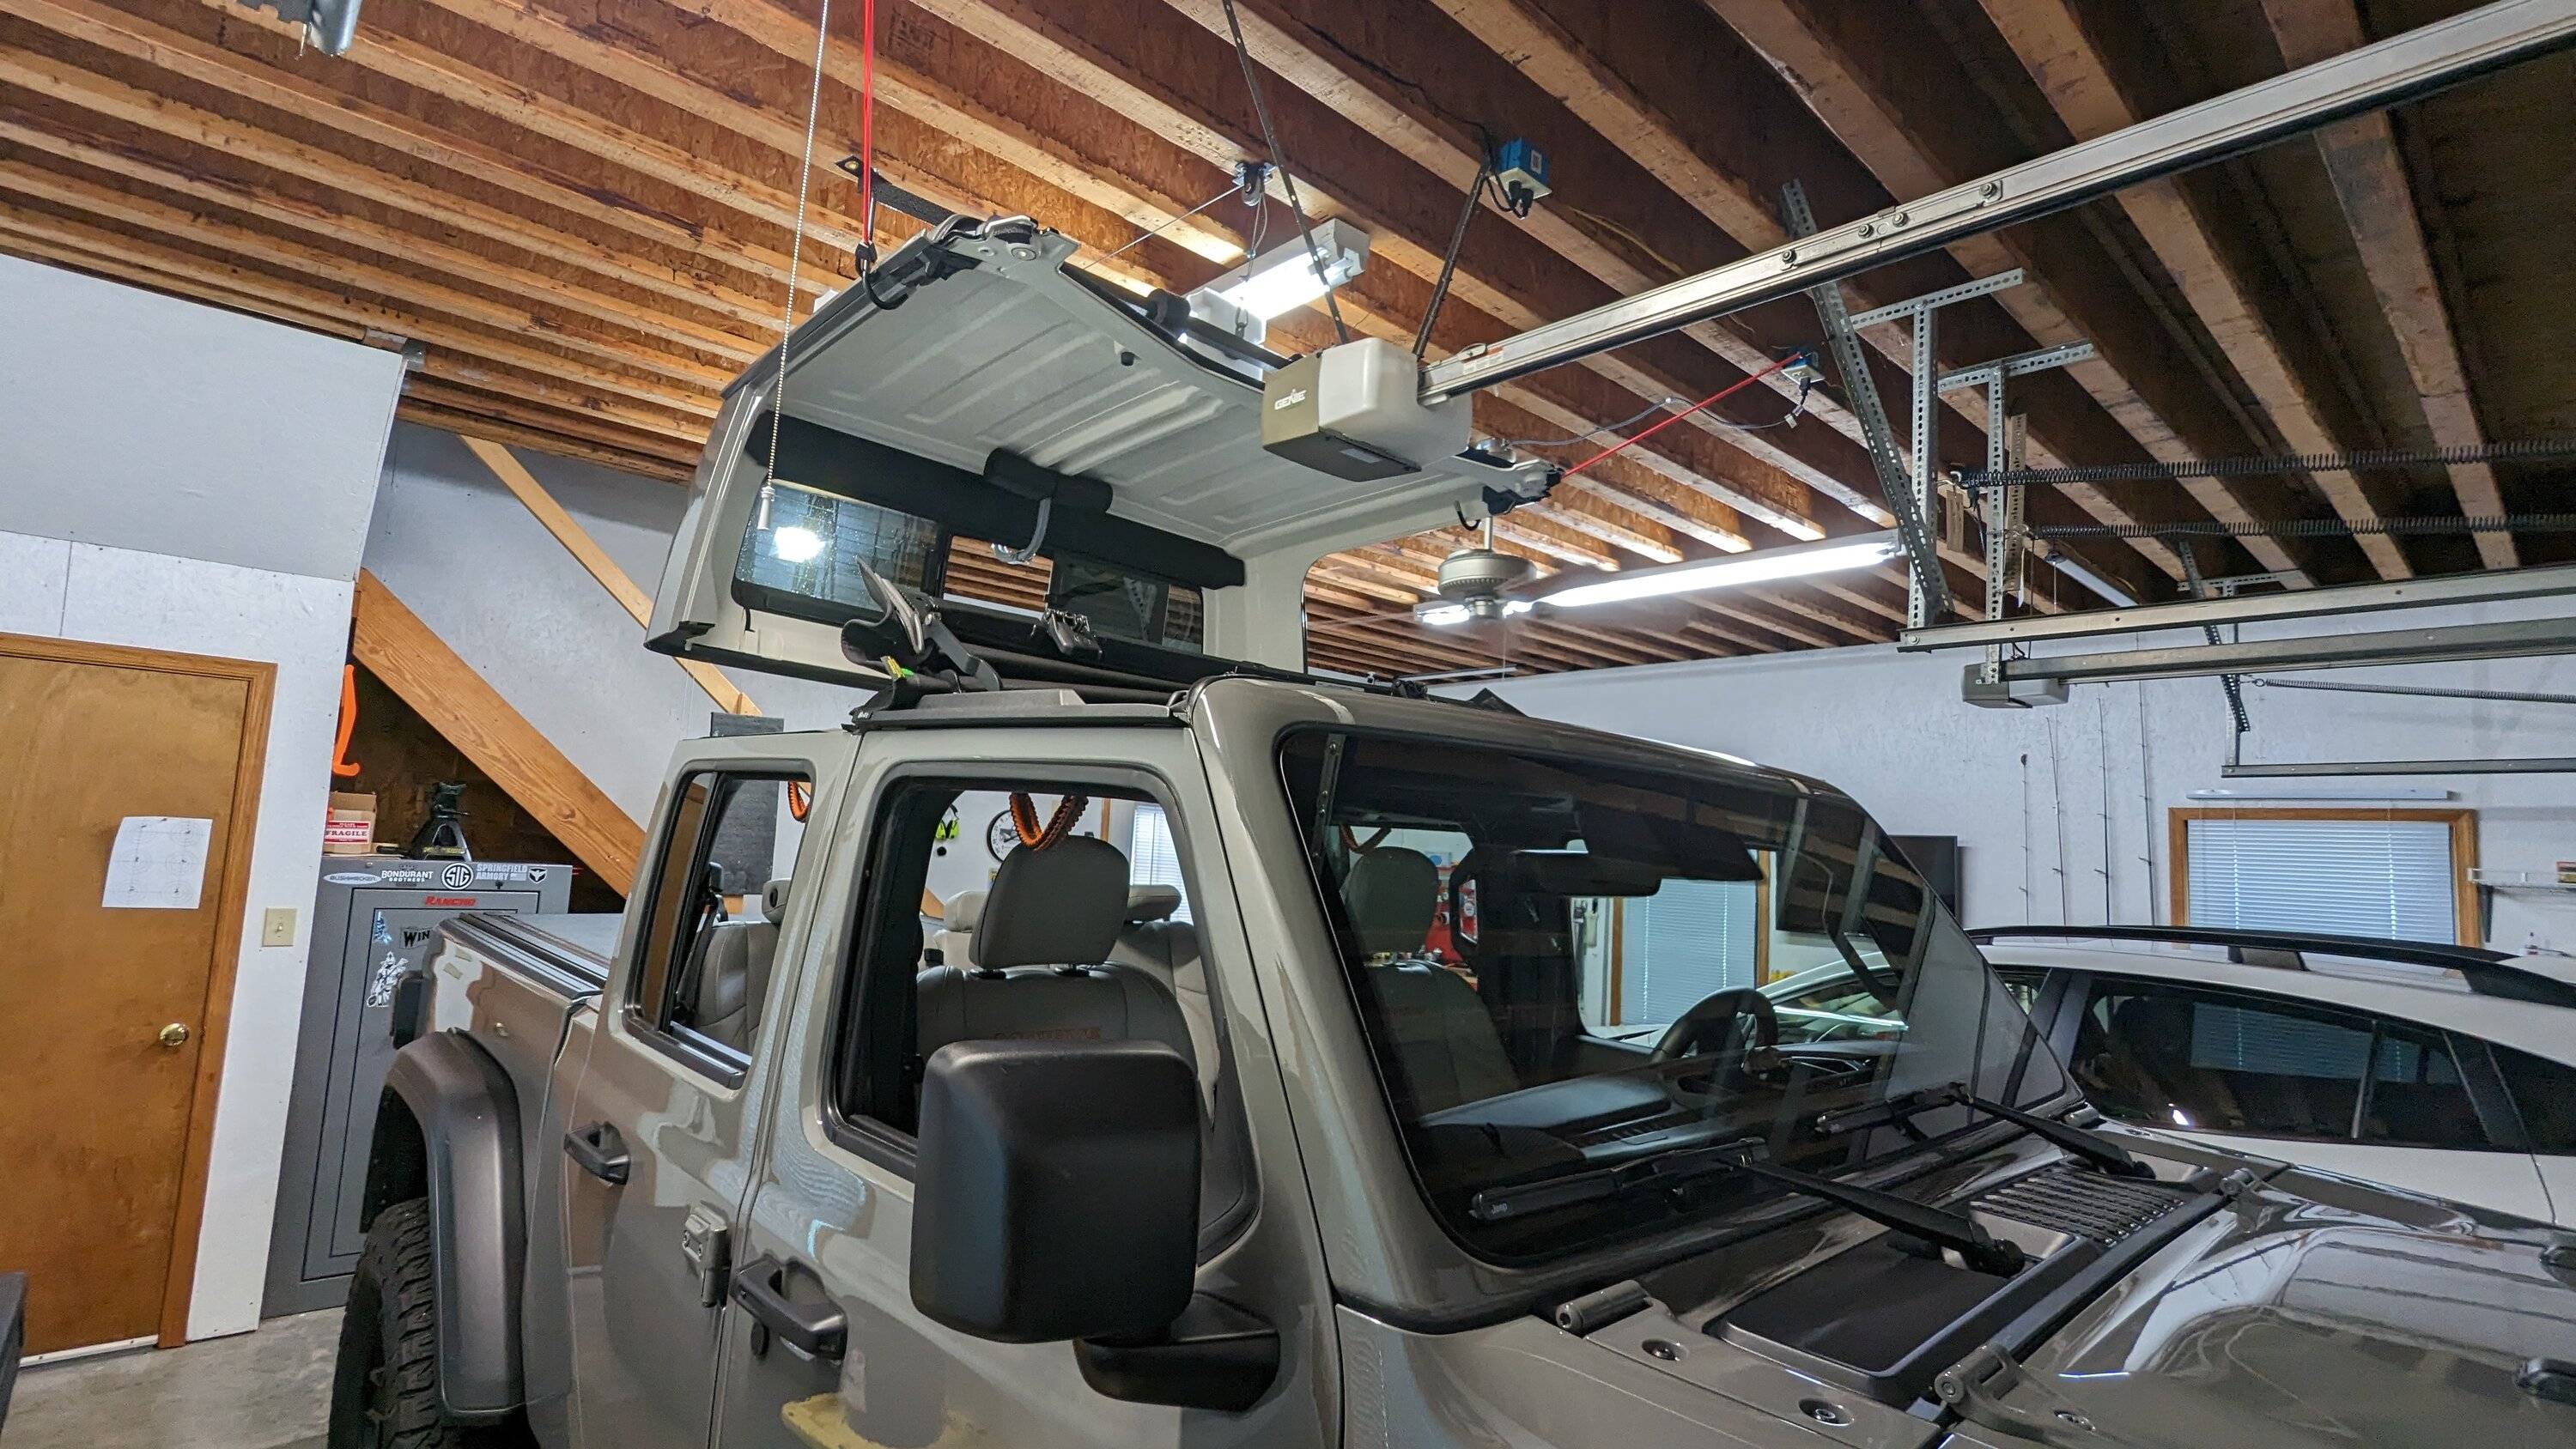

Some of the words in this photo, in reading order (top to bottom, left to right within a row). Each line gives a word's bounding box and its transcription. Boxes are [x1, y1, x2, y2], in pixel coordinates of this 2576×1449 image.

[1274, 388, 1307, 410] GENIE
[476, 863, 528, 873] SPRINGFIELD
[381, 870, 434, 880] BONDURANT
[446, 865, 471, 887] SIG
[475, 871, 508, 881] ARMORY
